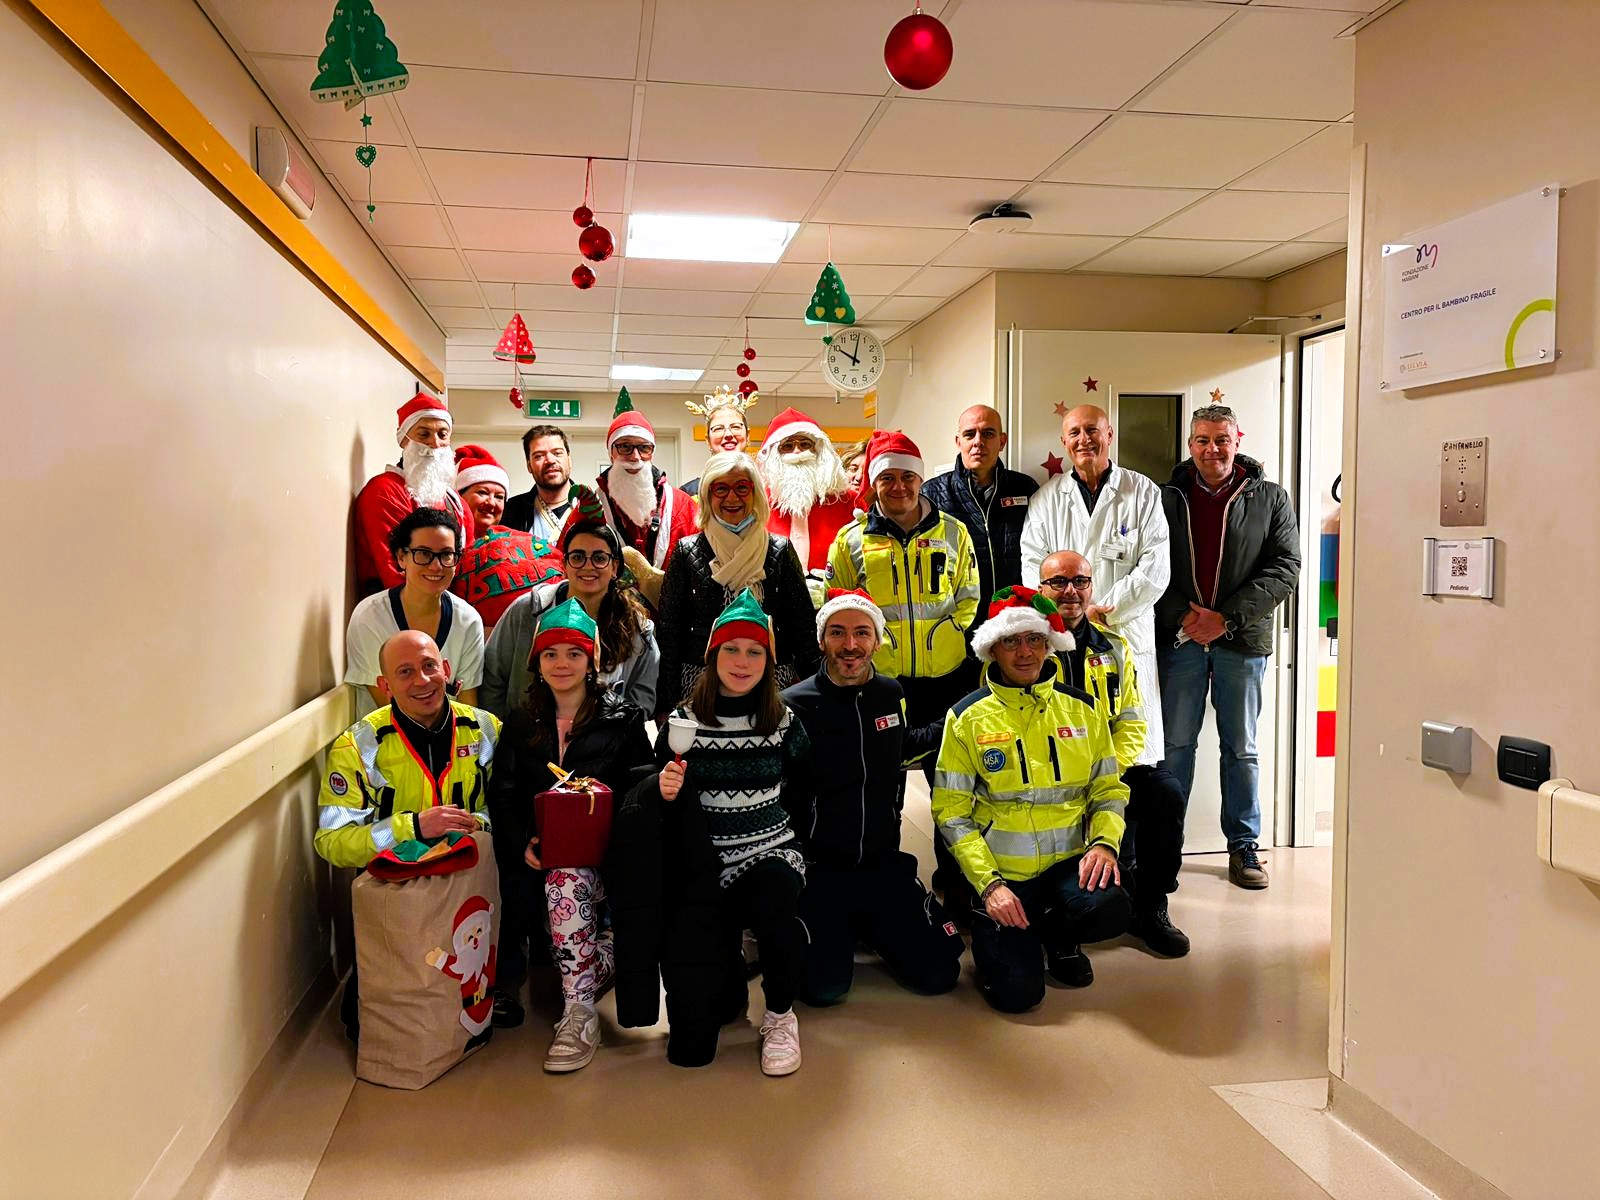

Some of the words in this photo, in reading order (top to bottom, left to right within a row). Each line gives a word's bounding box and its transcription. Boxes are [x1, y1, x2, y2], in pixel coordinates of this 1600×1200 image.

[1401, 264, 1429, 276] FONDAZIONE
[1400, 308, 1423, 319] CENTRO
[1423, 303, 1435, 313] PER
[1435, 301, 1441, 310] IL
[1441, 295, 1469, 308] BAMBINO
[1470, 287, 1496, 301] FRAGILE
